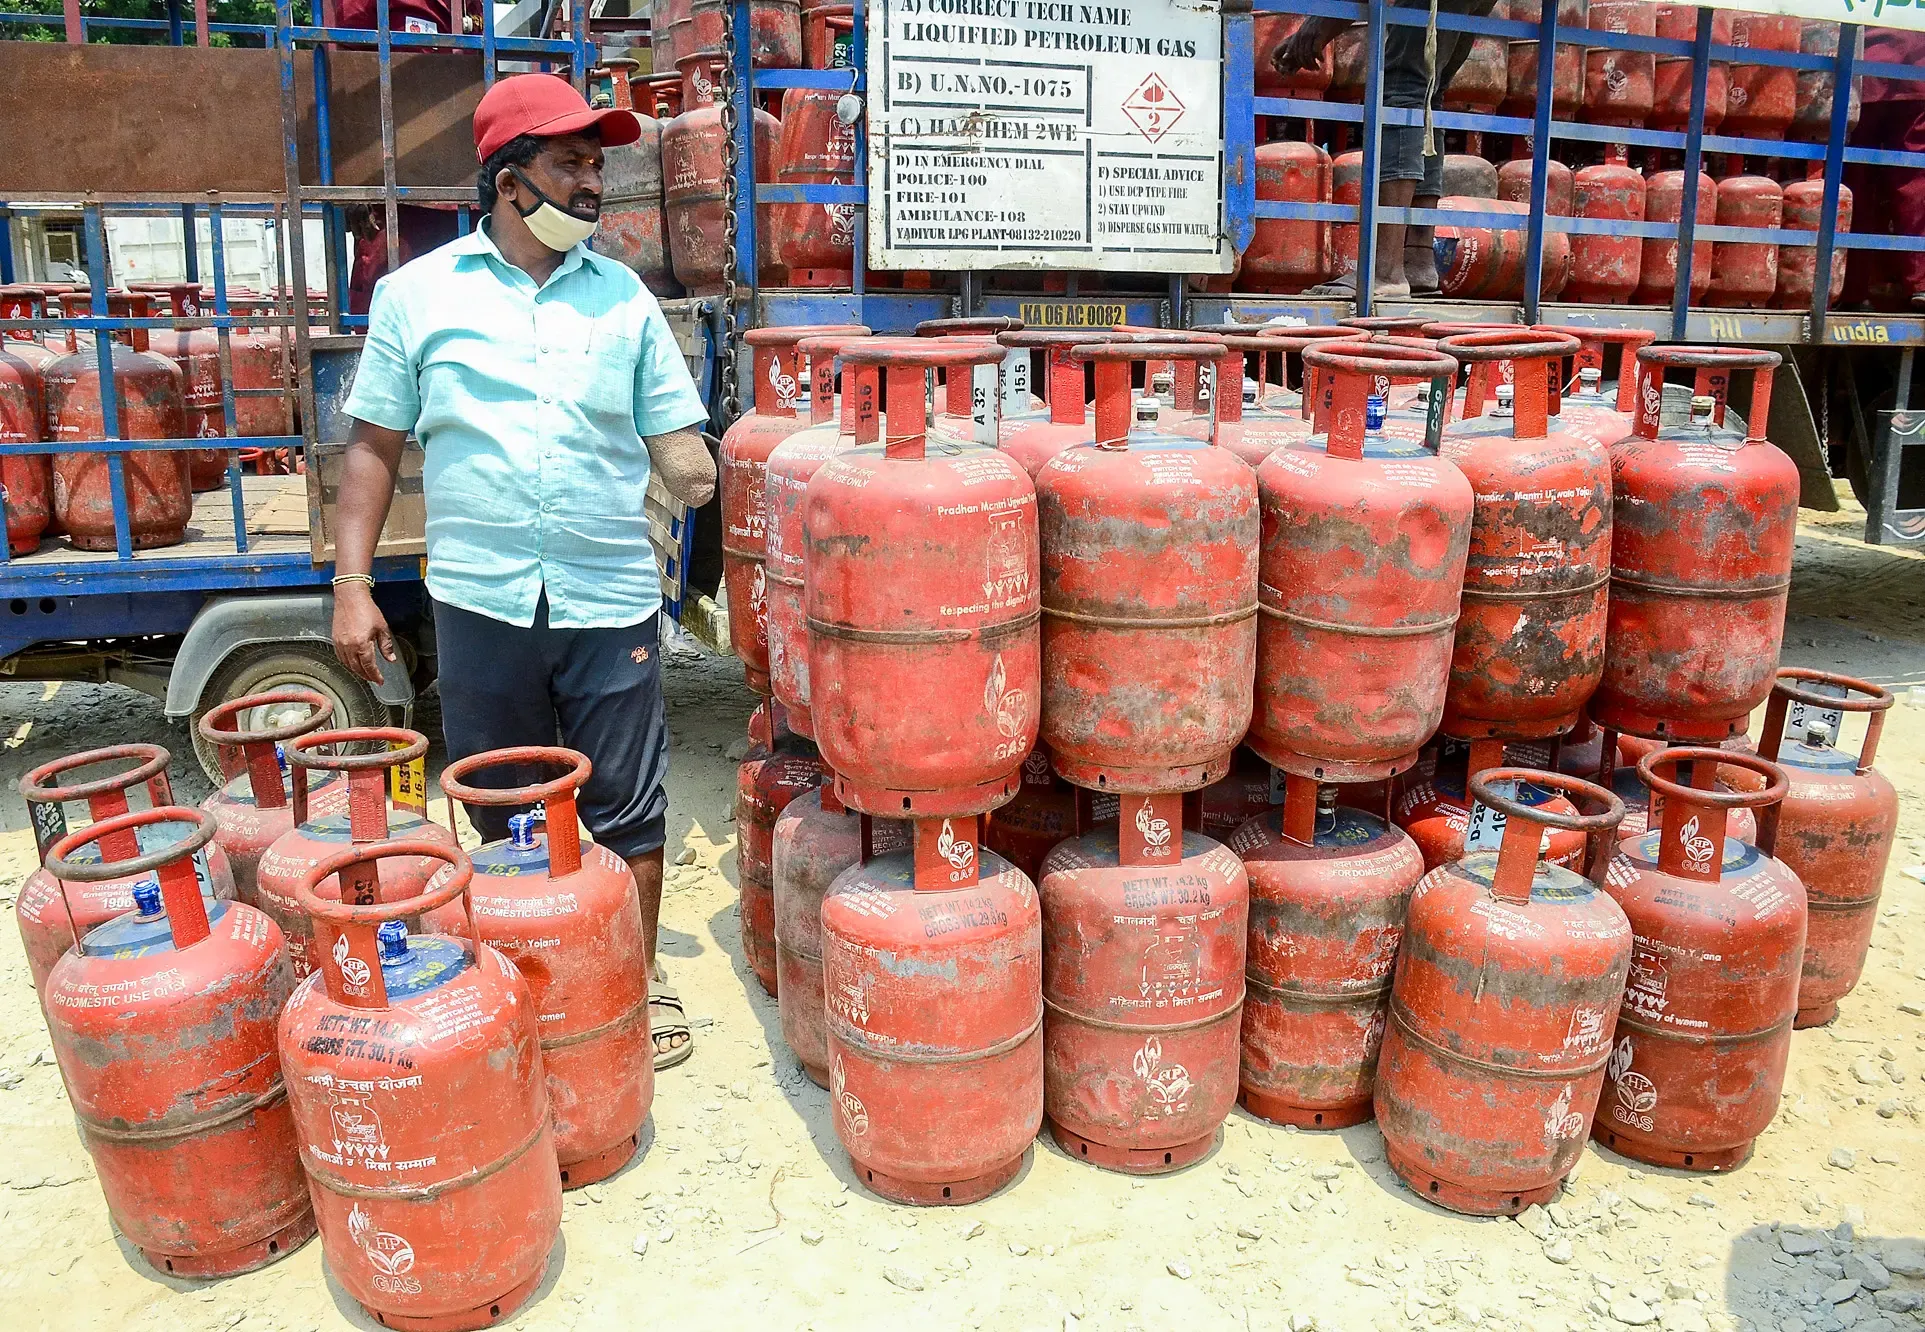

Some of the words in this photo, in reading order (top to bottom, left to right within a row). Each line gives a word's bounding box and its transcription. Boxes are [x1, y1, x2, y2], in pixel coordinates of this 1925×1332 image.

[900, 0, 921, 15] A)
[928, 0, 1020, 18] CORRECT
[1025, 1, 1073, 22] TECH
[1080, 5, 1132, 26] NAME
[903, 22, 1018, 47] LIQUIFIED
[1024, 30, 1150, 55] PETROLEUM
[1157, 38, 1196, 58] GAS
[898, 72, 922, 94] B)
[900, 118, 921, 138] C)
[1036, 122, 1078, 142] 2WE
[1148, 112, 1160, 134] 2
[896, 155, 910, 168] D)
[914, 156, 929, 168] IN
[934, 156, 1012, 168] EMERGENCY
[1016, 158, 1044, 170] DIAL
[896, 173, 988, 186] POLICE-100
[1098, 166, 1110, 180] F)
[1112, 166, 1160, 180] SPECIAL
[1163, 169, 1204, 182] ADVICE
[896, 191, 966, 204] FIRE-101
[1099, 185, 1106, 198] 1)
[1109, 186, 1126, 197] USE
[1128, 186, 1144, 198] DCP
[1145, 186, 1166, 198] TYPE
[1168, 188, 1188, 199] FIRE
[896, 210, 1026, 222] AMBULANCE-108
[1098, 203, 1106, 216] 2)
[1108, 204, 1130, 215] STAY
[1132, 204, 1166, 216] UPWIND
[896, 228, 945, 240] YADIYUR
[949, 228, 969, 240] LPG
[1098, 221, 1106, 234] 3)
[1108, 222, 1145, 233] DISPERSE
[1146, 222, 1160, 234] GAS
[1162, 223, 1182, 234] WITH
[1184, 224, 1210, 236] WATER
[1023, 304, 1042, 324] KA
[1045, 304, 1062, 325] 06
[1066, 304, 1084, 325] AC
[1087, 304, 1122, 326] 0082
[1000, 368, 1007, 388] 28
[1015, 364, 1026, 394] 15.5
[1198, 366, 1212, 400] D-27
[974, 387, 986, 409] 32
[974, 414, 986, 426] A
[1514, 490, 1543, 501] Mantri
[938, 503, 978, 516] Pradhan
[992, 600, 1004, 610] the
[995, 736, 1027, 760] GAS
[1838, 792, 1856, 800] ONLY
[1470, 804, 1487, 842] D-28
[954, 844, 969, 854] HP
[1694, 840, 1710, 848] HP
[1682, 860, 1710, 874] GAS
[1122, 877, 1150, 893] NETT
[1198, 874, 1208, 890] kg
[1178, 890, 1198, 905] 30.2
[1200, 890, 1210, 906] kg
[482, 906, 531, 918] DOMESTIC
[534, 908, 553, 918] USE
[554, 904, 578, 915] ONLY
[527, 938, 561, 950] Yojana
[348, 961, 363, 970] HP
[102, 980, 137, 994] उपयोग
[66, 995, 121, 1008] DOMESTIC
[124, 990, 151, 1004] USE
[1156, 998, 1168, 1008] को
[1172, 992, 1194, 1008] मिला
[1198, 989, 1222, 1003] सम्मान
[465, 1003, 478, 1013] OFF
[1664, 1014, 1675, 1023] of
[1674, 1016, 1709, 1028] women
[378, 1074, 424, 1091] योजना
[1628, 1074, 1650, 1091] HP
[844, 1096, 862, 1114] HP
[1612, 1104, 1654, 1132] GAS
[365, 1158, 392, 1171] मिला
[376, 1236, 401, 1251] HP
[372, 1274, 422, 1294] GAS
